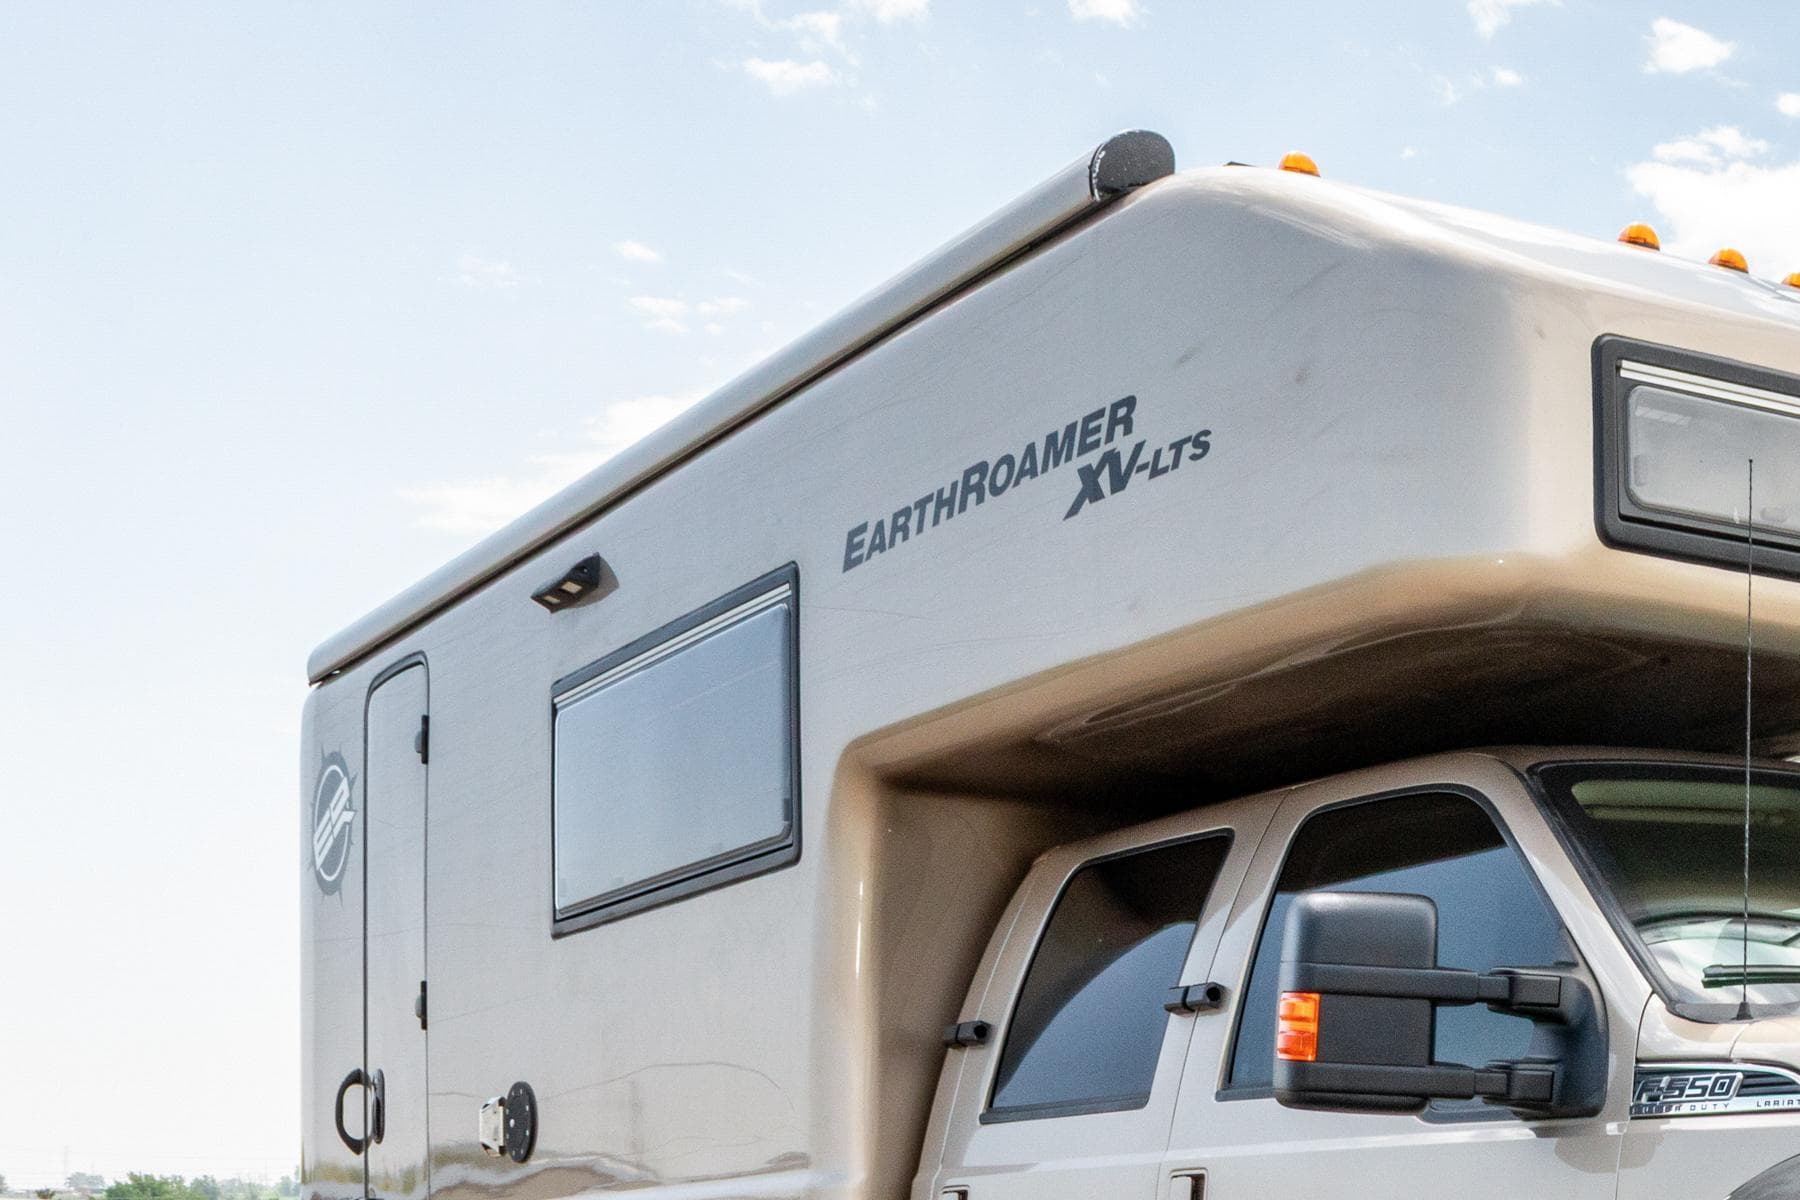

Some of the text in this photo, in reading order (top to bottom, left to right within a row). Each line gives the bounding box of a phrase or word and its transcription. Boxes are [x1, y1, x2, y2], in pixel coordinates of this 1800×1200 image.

[842, 395, 1137, 573] EARTHROAMER
[1063, 429, 1212, 521] XV-LTS
[1689, 1102, 1730, 1112] DUTY
